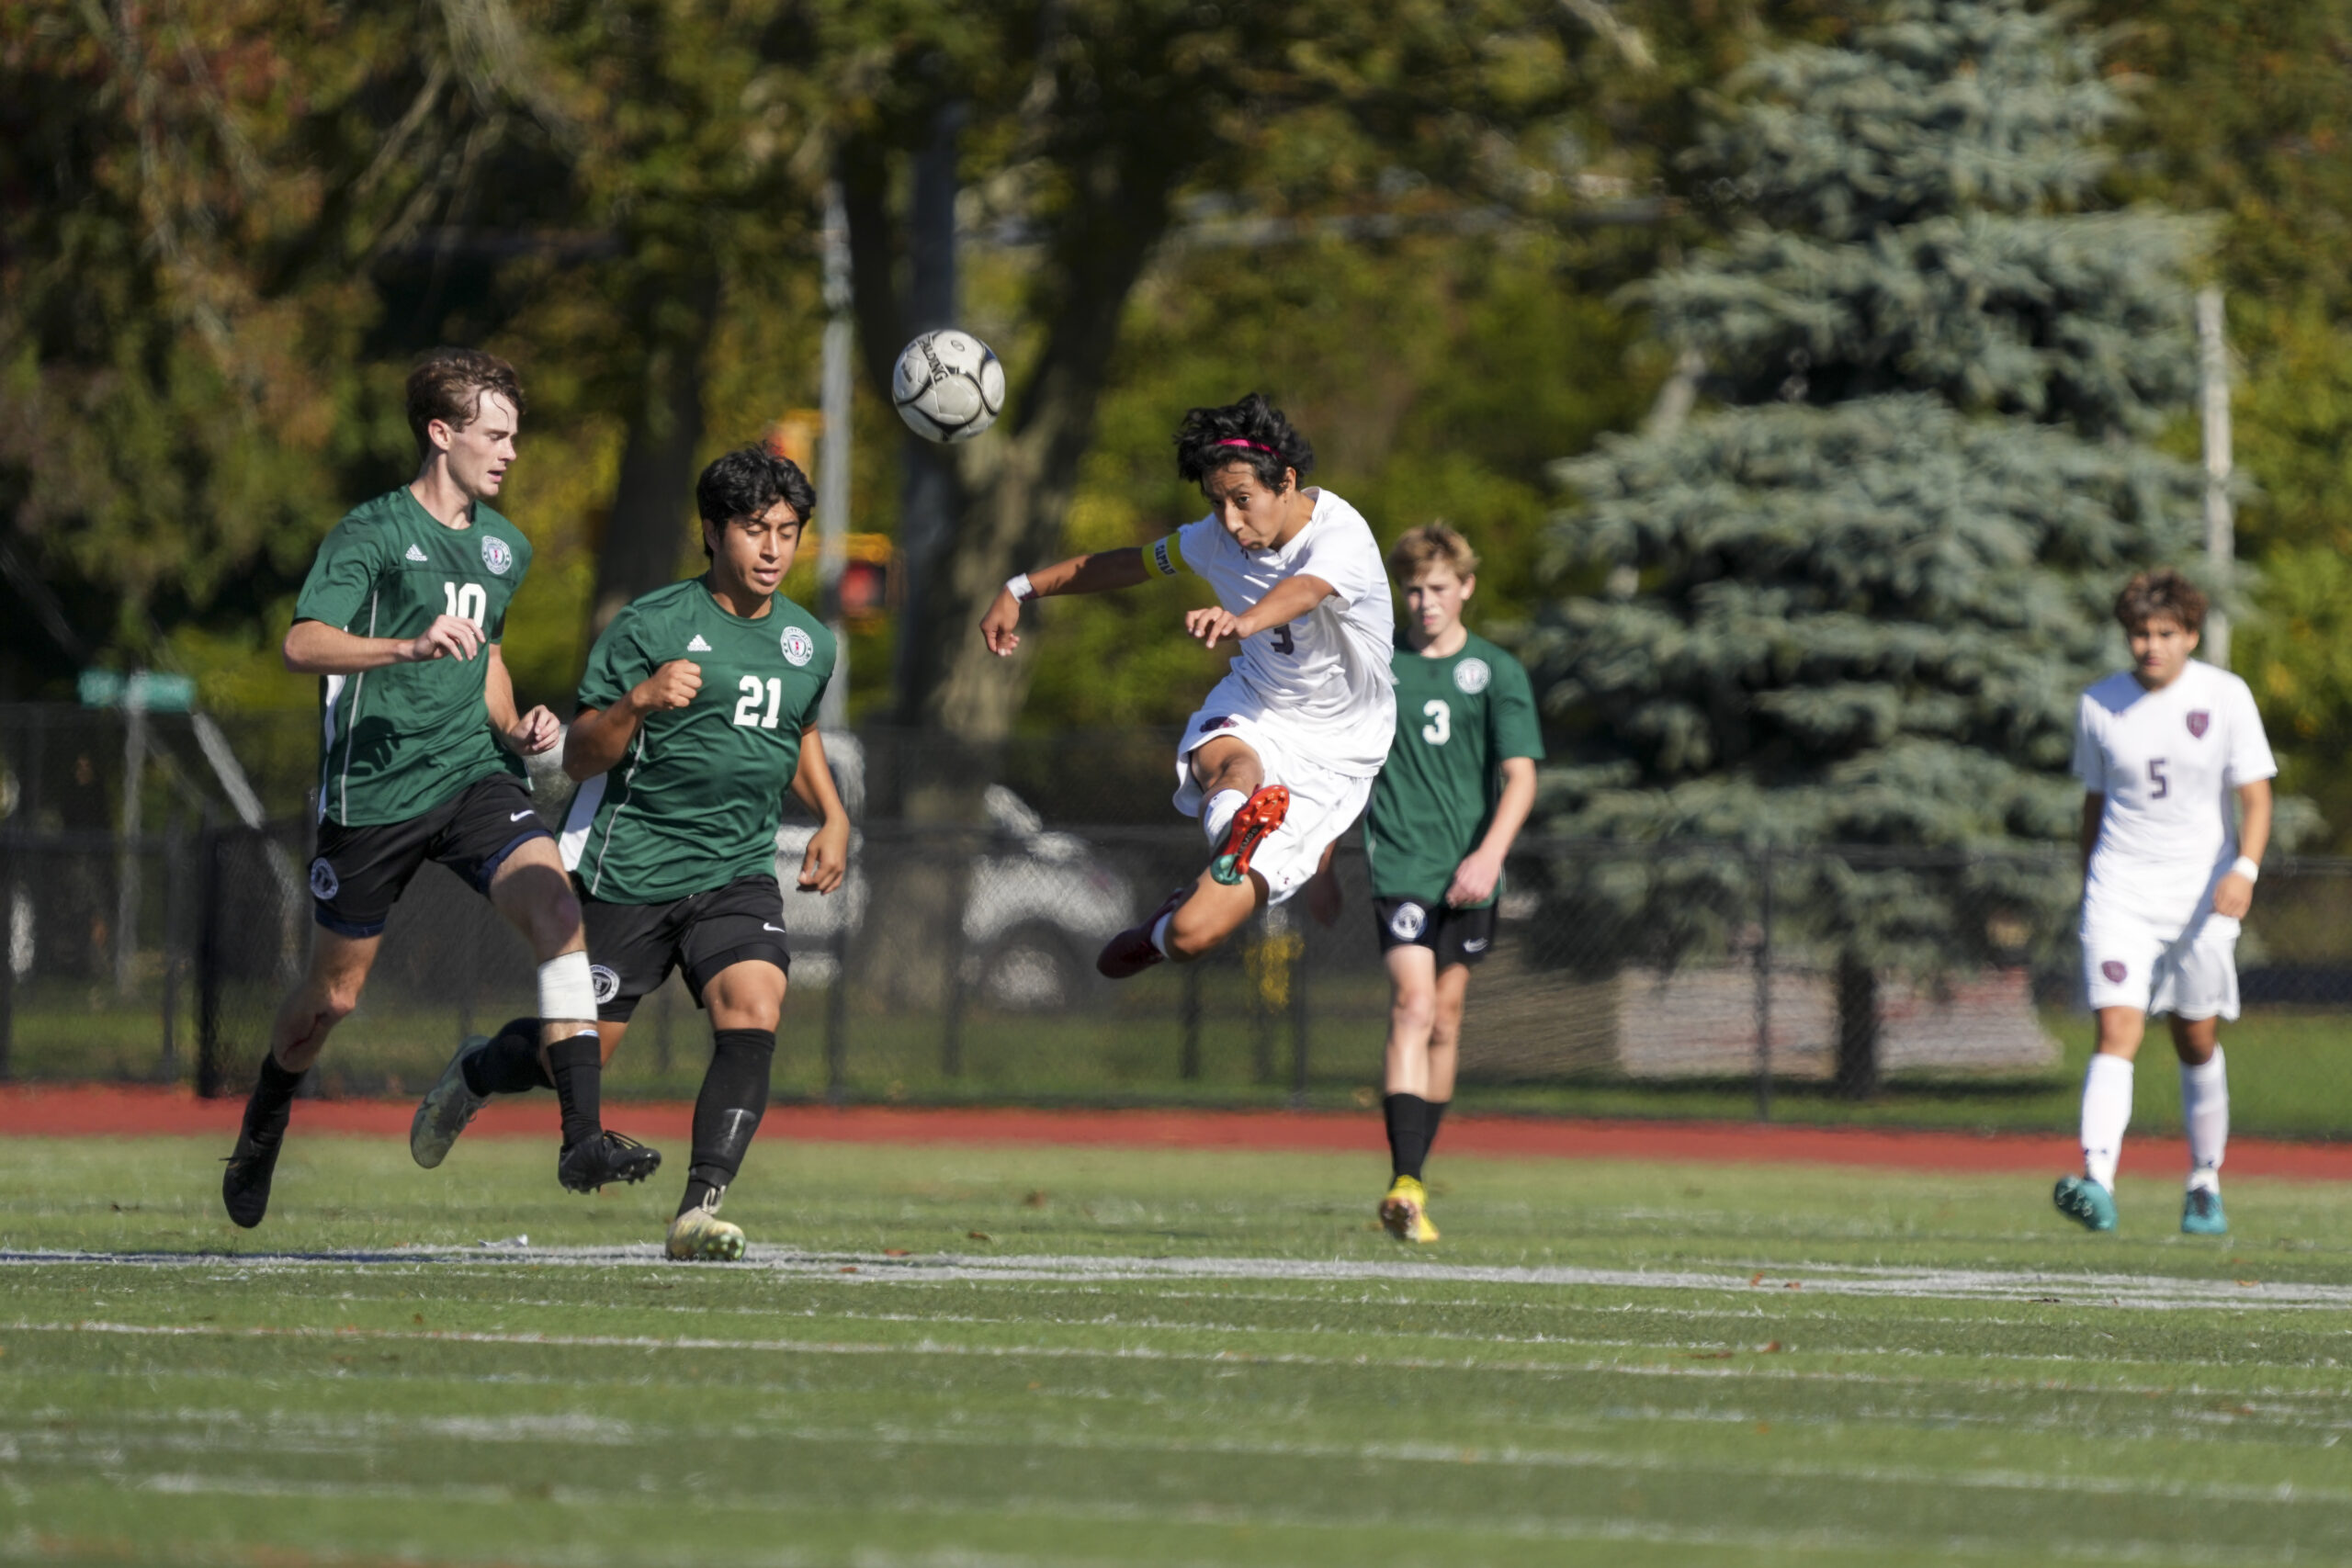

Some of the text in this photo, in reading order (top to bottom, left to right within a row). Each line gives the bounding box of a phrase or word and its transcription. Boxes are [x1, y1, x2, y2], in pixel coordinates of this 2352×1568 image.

[915, 333, 949, 383] PALDING
[444, 581, 487, 629] 10
[733, 674, 782, 728] 21
[1422, 699, 1451, 746] 3
[2148, 758, 2168, 800] 5
